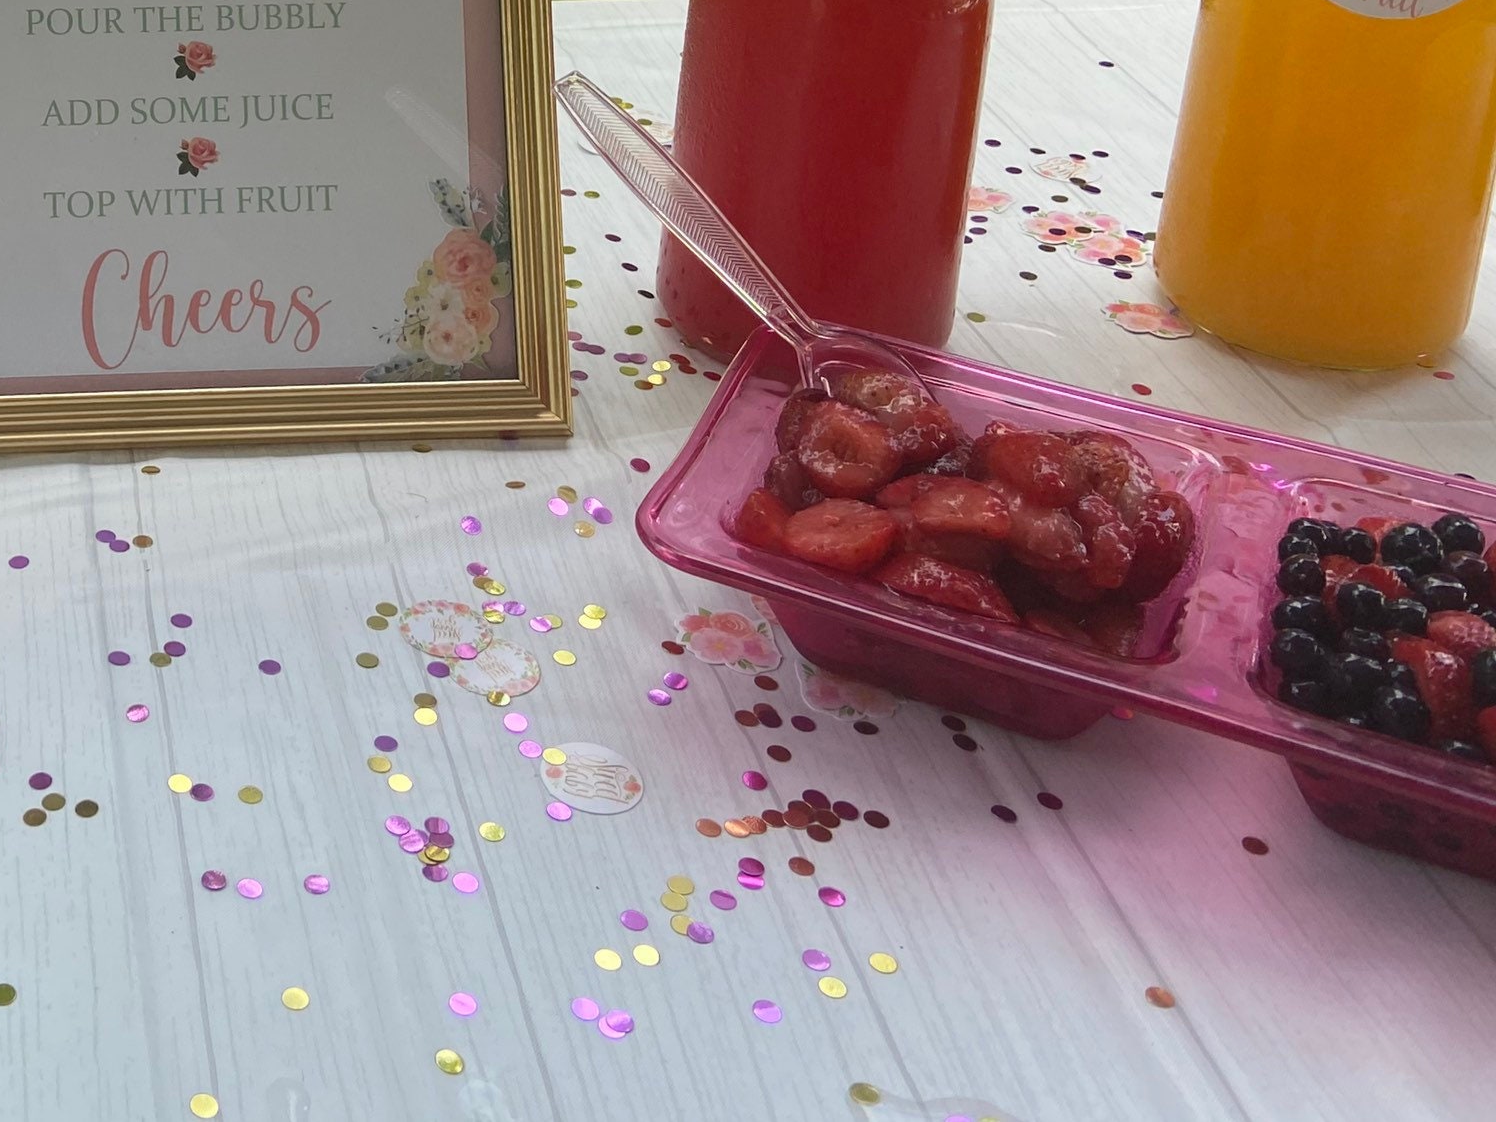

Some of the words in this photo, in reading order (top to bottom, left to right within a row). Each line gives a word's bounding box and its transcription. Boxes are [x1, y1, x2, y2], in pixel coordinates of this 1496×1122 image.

[25, 8, 125, 36] POUR
[133, 5, 205, 34] THE
[215, 2, 347, 32] BUBBLY
[41, 98, 120, 127] ADD
[129, 95, 230, 125] SOME
[239, 93, 335, 128] JUICE
[43, 190, 116, 219] TOP
[124, 187, 224, 217] WITH
[235, 184, 339, 214] FRUIT
[81, 248, 333, 370] Cheers
